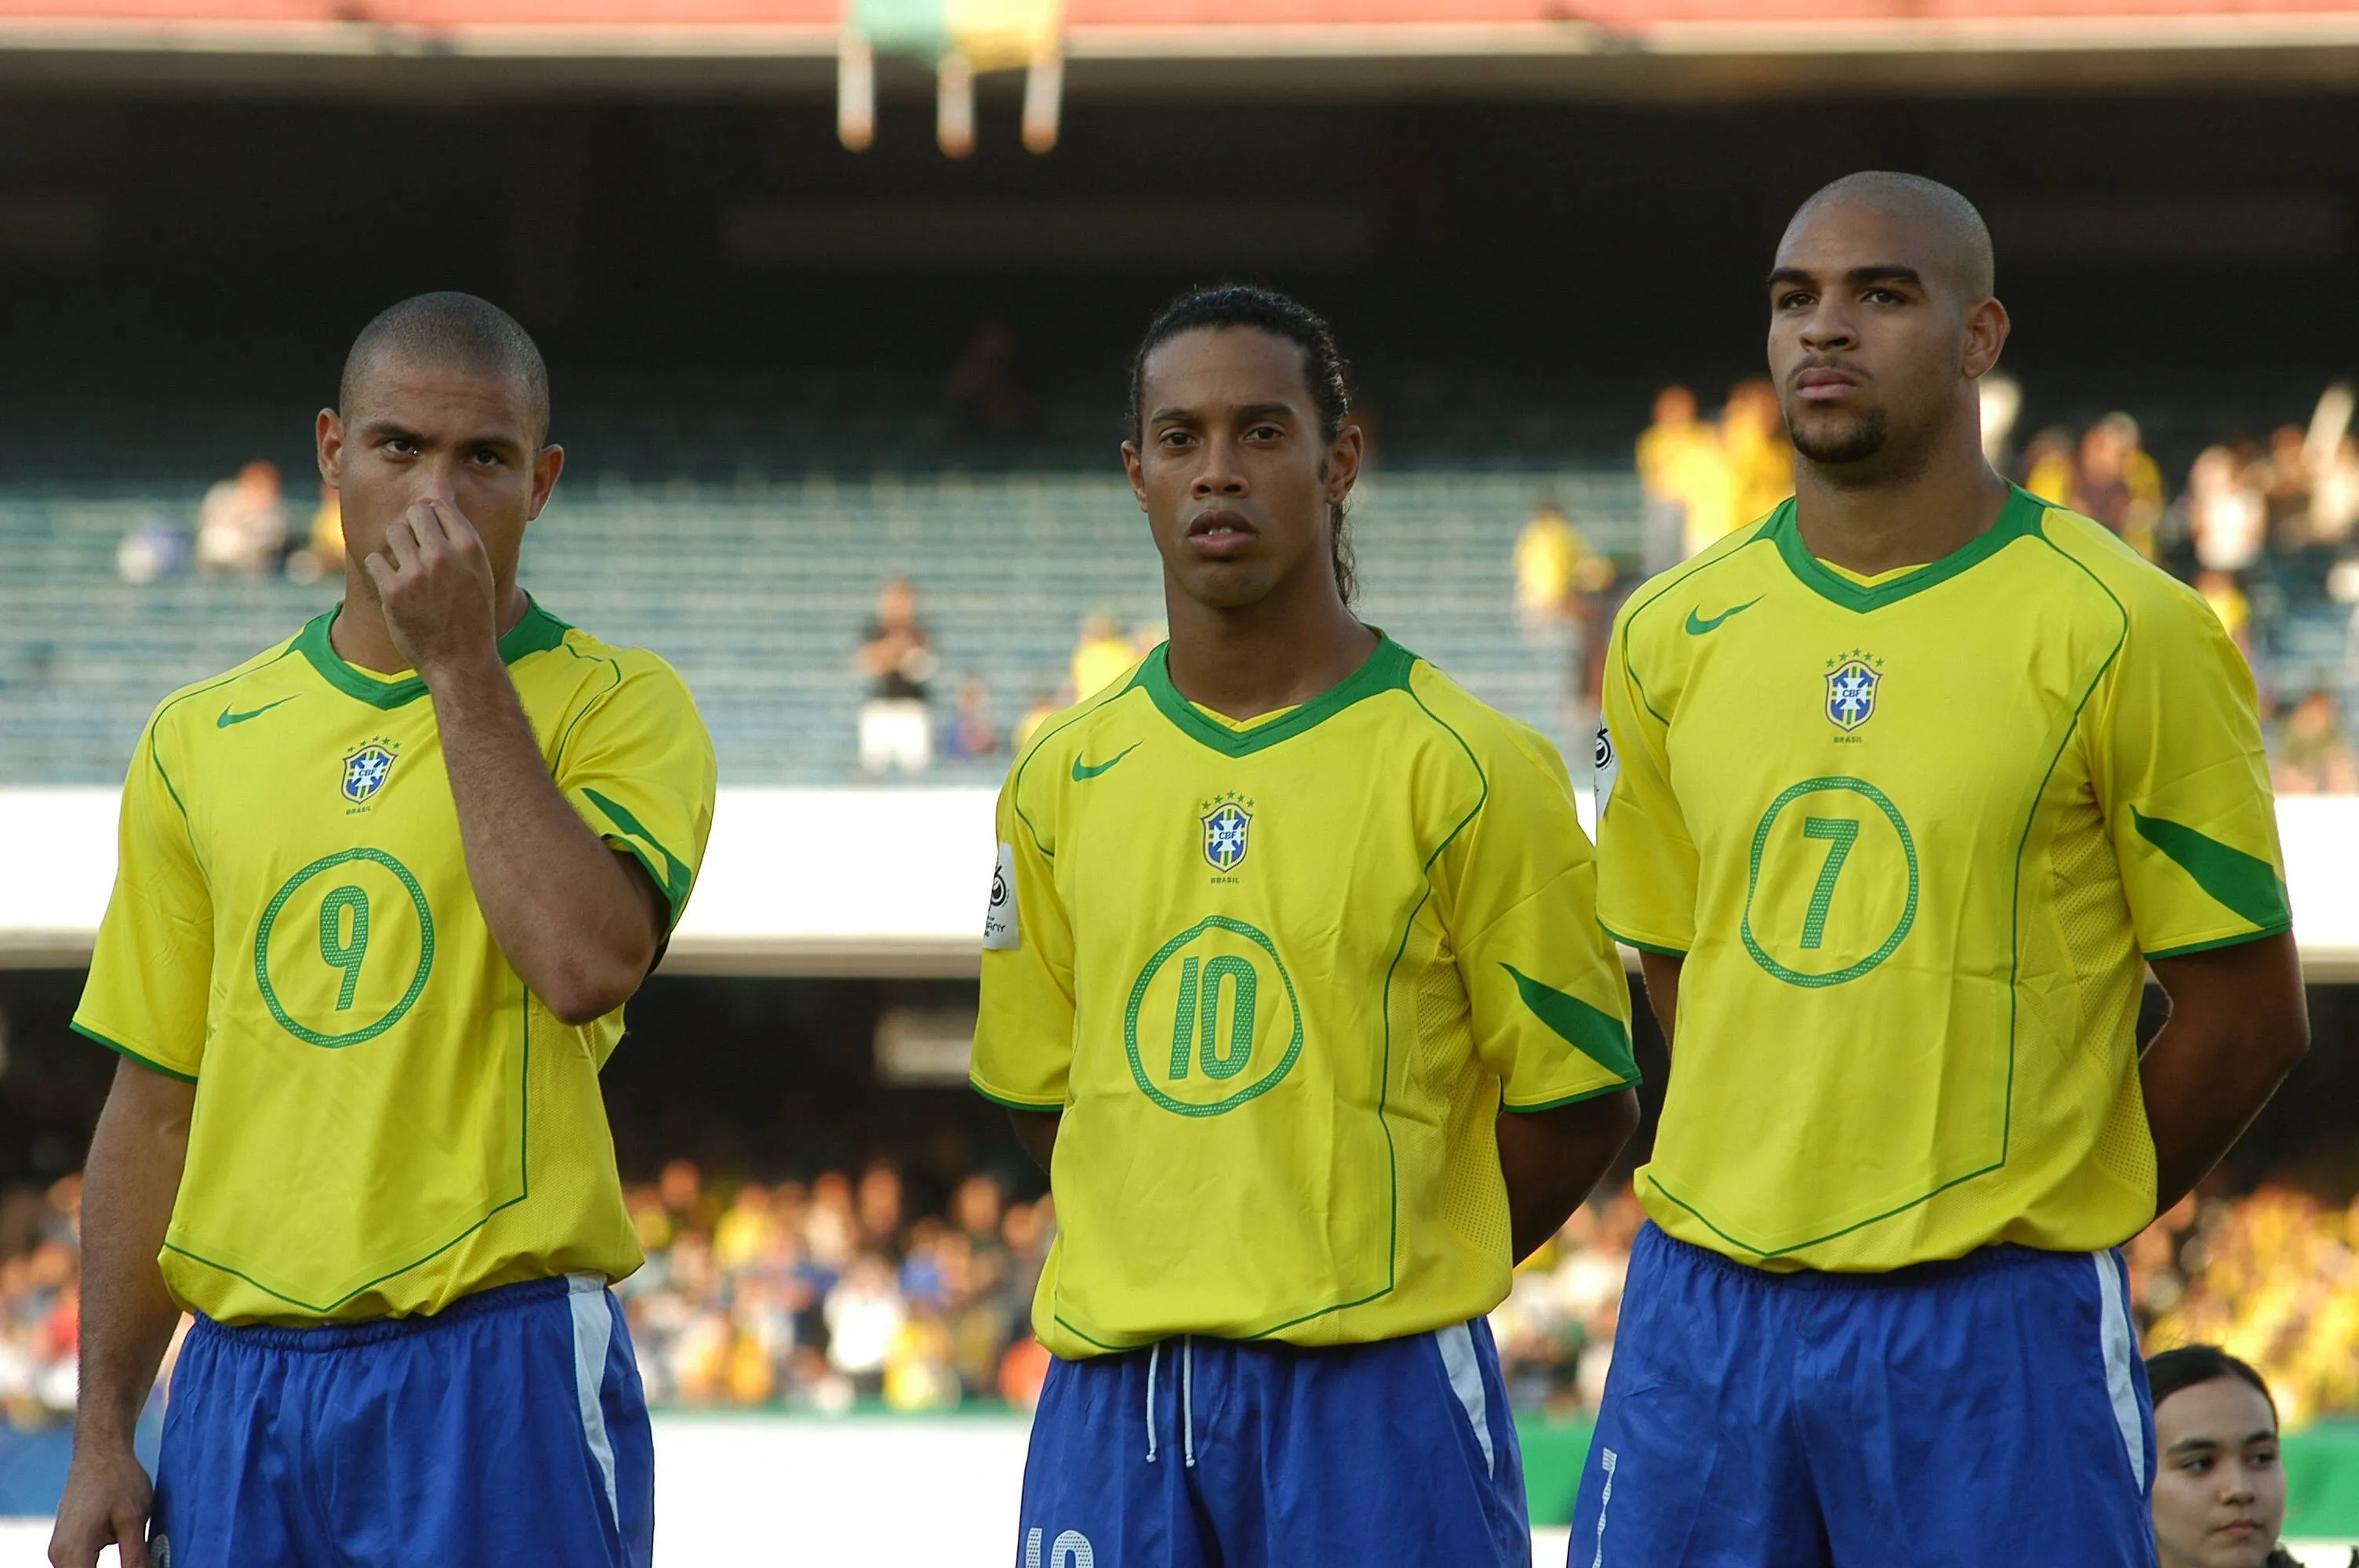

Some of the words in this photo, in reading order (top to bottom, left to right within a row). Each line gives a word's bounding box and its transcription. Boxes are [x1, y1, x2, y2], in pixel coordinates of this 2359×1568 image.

[1841, 689, 1862, 698] CBF
[1218, 831, 1237, 840] CBF
[1800, 816, 1859, 949] 7
[319, 885, 369, 1011] 9
[1169, 956, 1257, 1080] 10
